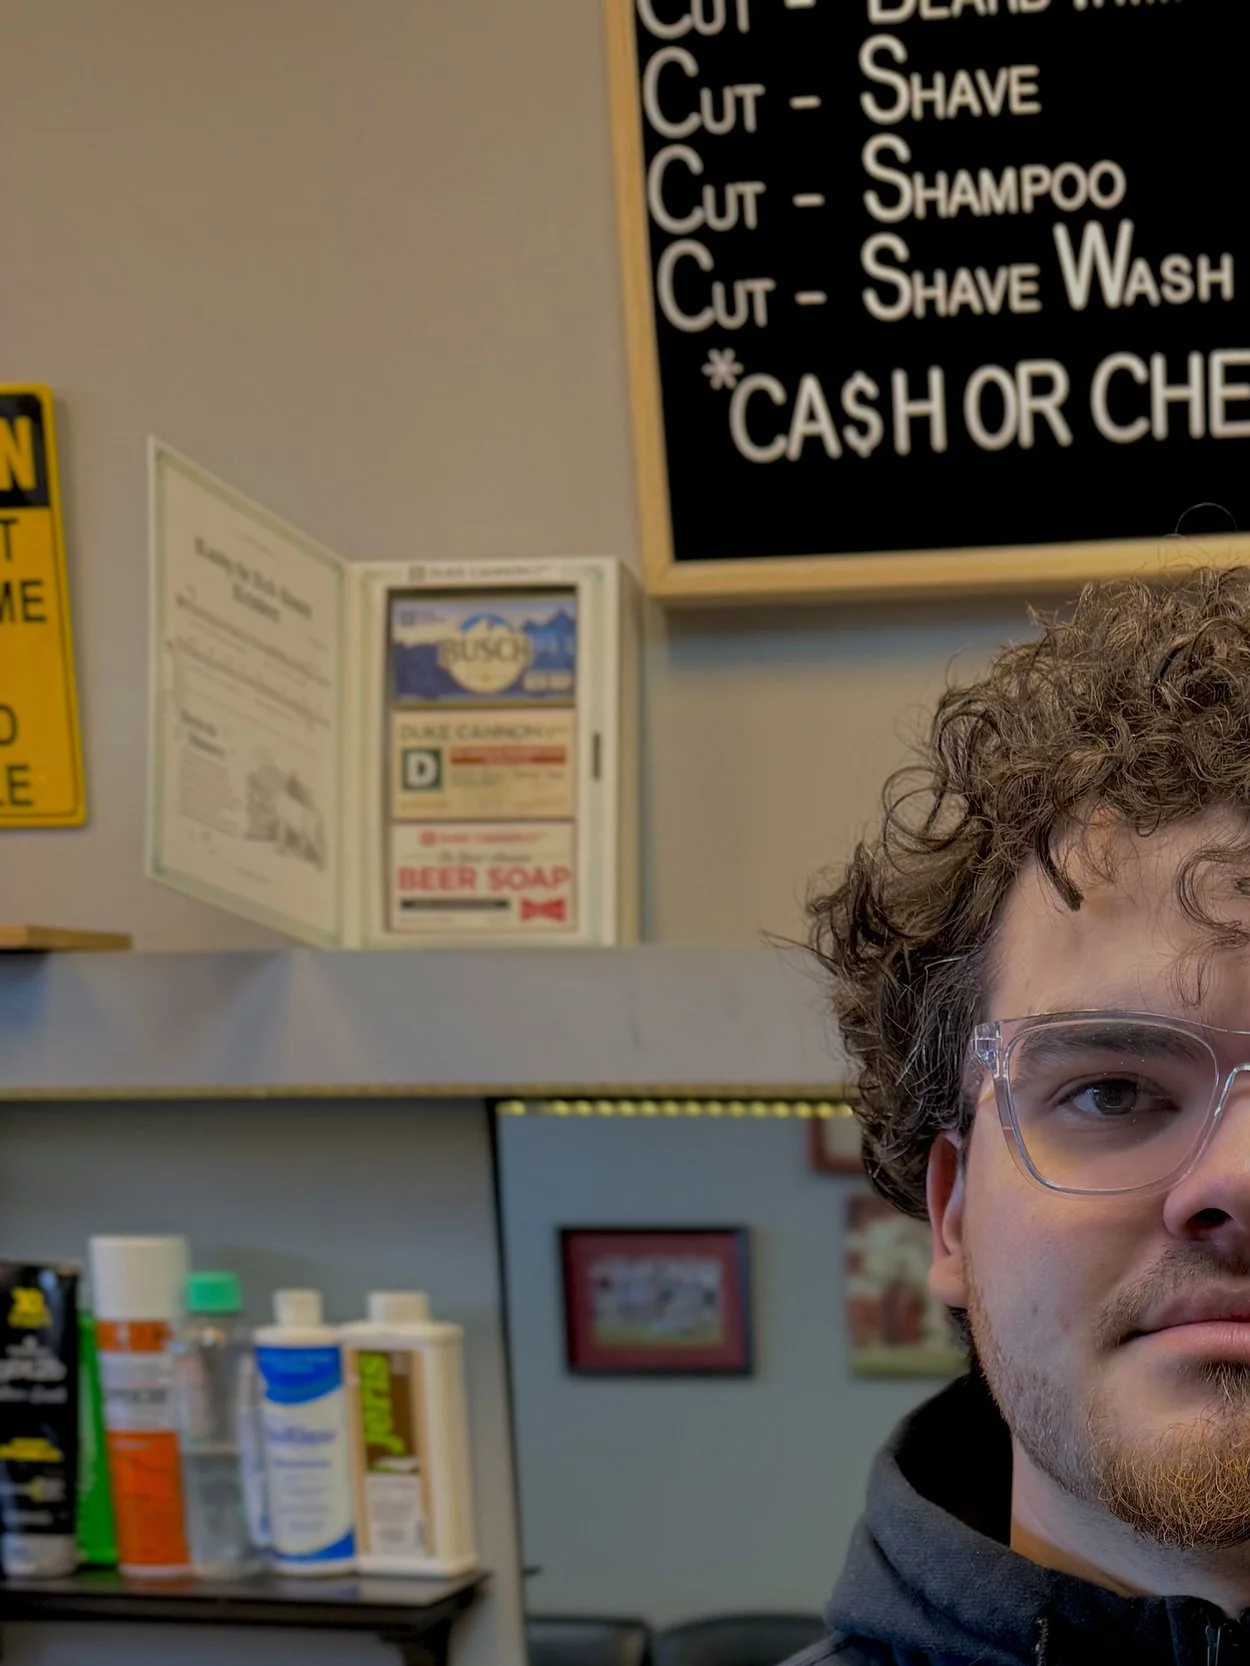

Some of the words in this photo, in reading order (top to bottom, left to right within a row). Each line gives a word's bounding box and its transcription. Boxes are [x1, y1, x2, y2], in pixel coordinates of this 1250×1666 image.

[860, 35, 1041, 124] SHAVE
[862, 134, 1126, 222] SHAMPOO
[861, 234, 1041, 321] SHAVE
[1054, 219, 1234, 309] WASH
[965, 360, 1072, 450] OR
[397, 866, 478, 891] BEER
[487, 865, 571, 891] SOAP
